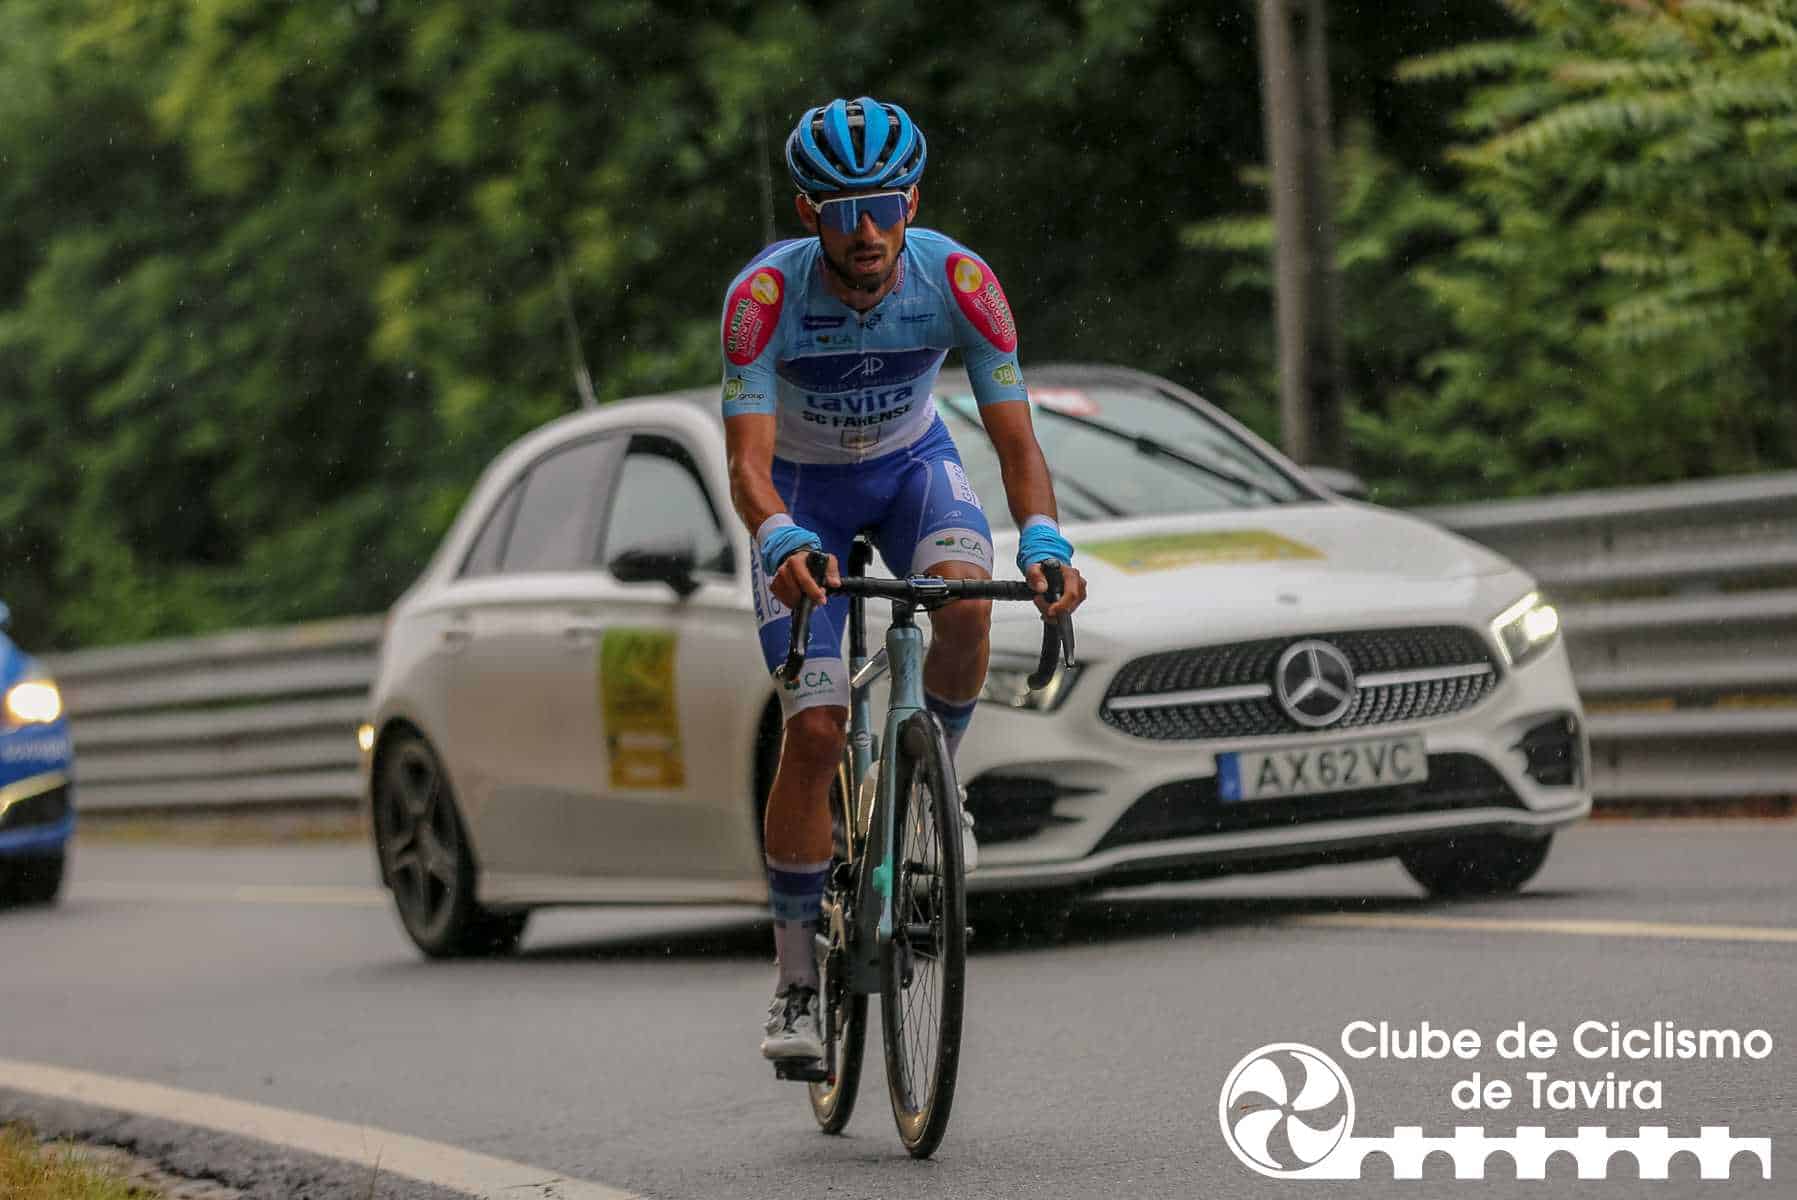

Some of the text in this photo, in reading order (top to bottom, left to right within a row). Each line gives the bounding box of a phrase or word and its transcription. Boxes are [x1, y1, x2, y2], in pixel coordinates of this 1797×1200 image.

[737, 303, 761, 353] AVOCADOS
[739, 392, 765, 400] group
[801, 409, 827, 425] SC
[960, 537, 984, 555] CA
[804, 671, 833, 688] CA
